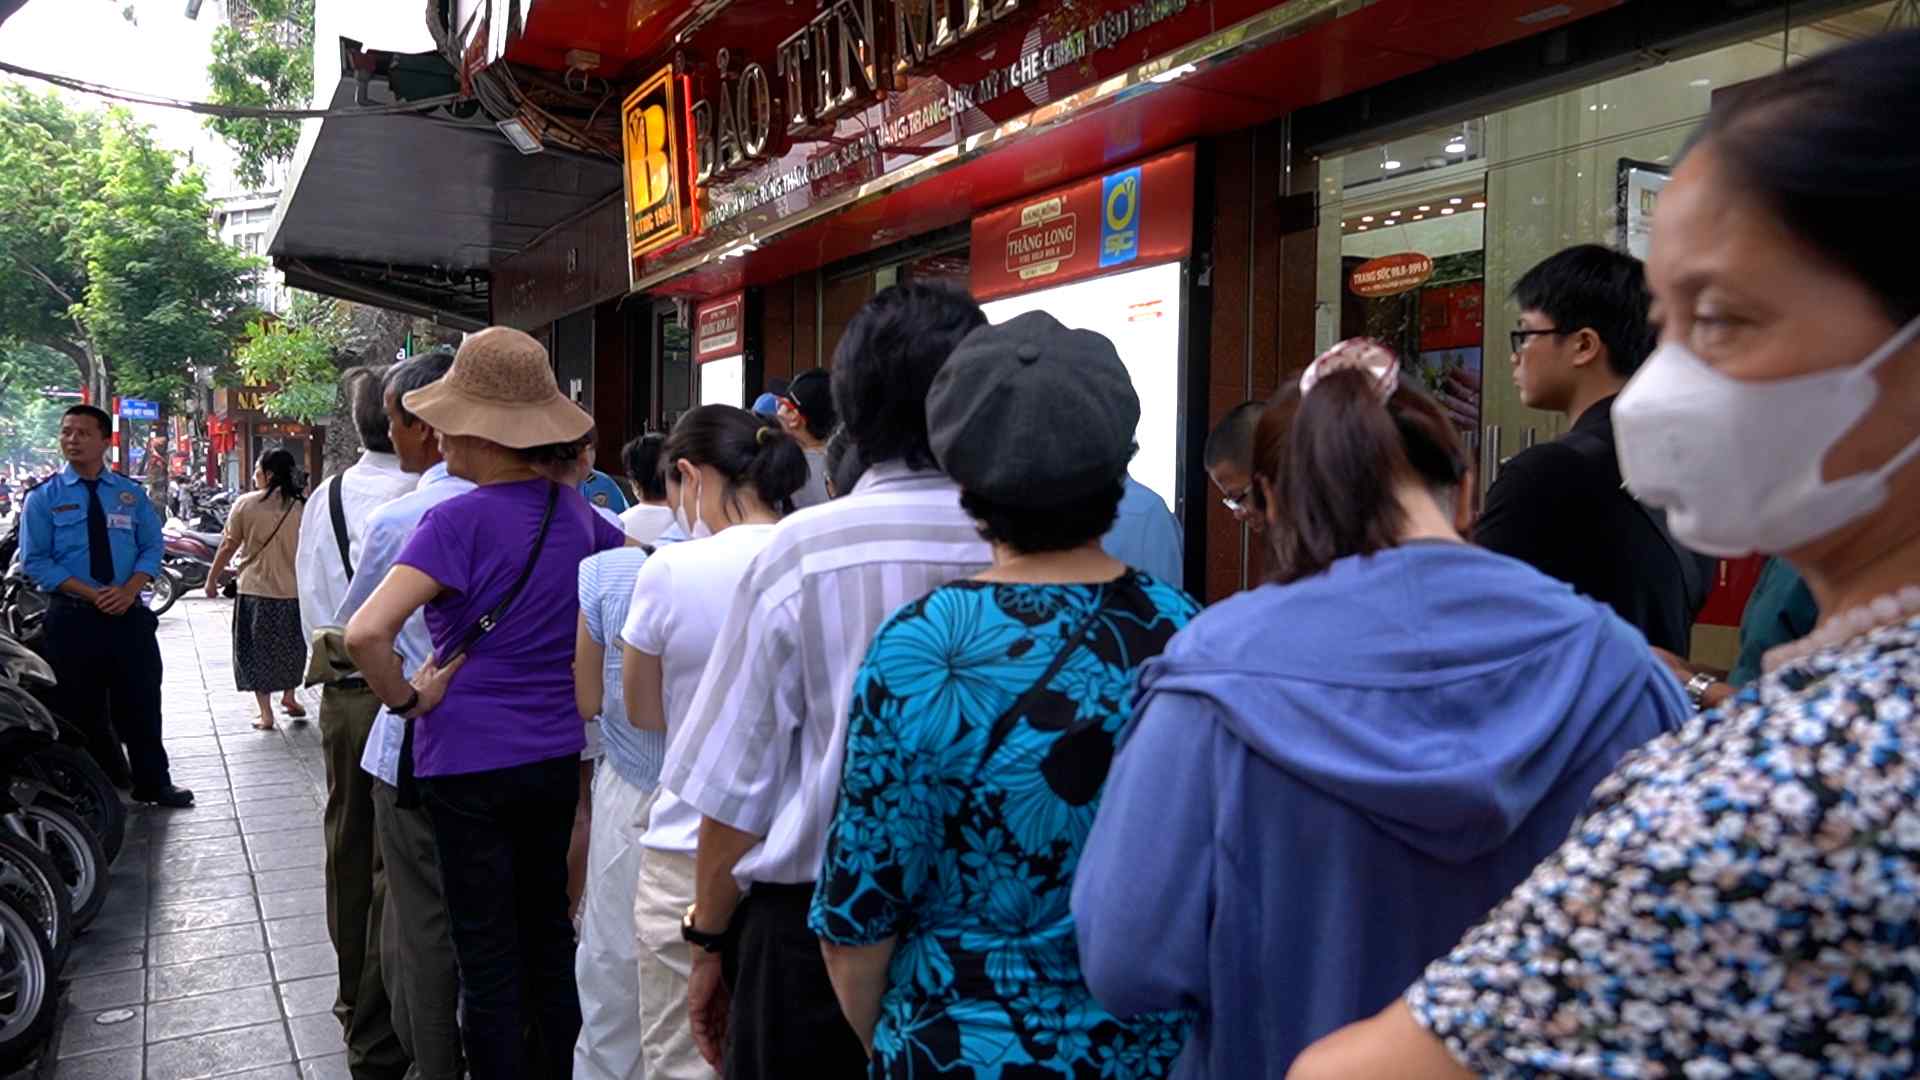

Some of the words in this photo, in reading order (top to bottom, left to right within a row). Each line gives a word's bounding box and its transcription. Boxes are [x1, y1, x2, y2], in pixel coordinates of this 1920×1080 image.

[908, 98, 948, 137] TRANG
[1007, 234, 1042, 257] THĂNG
[1044, 225, 1074, 247] LONG
